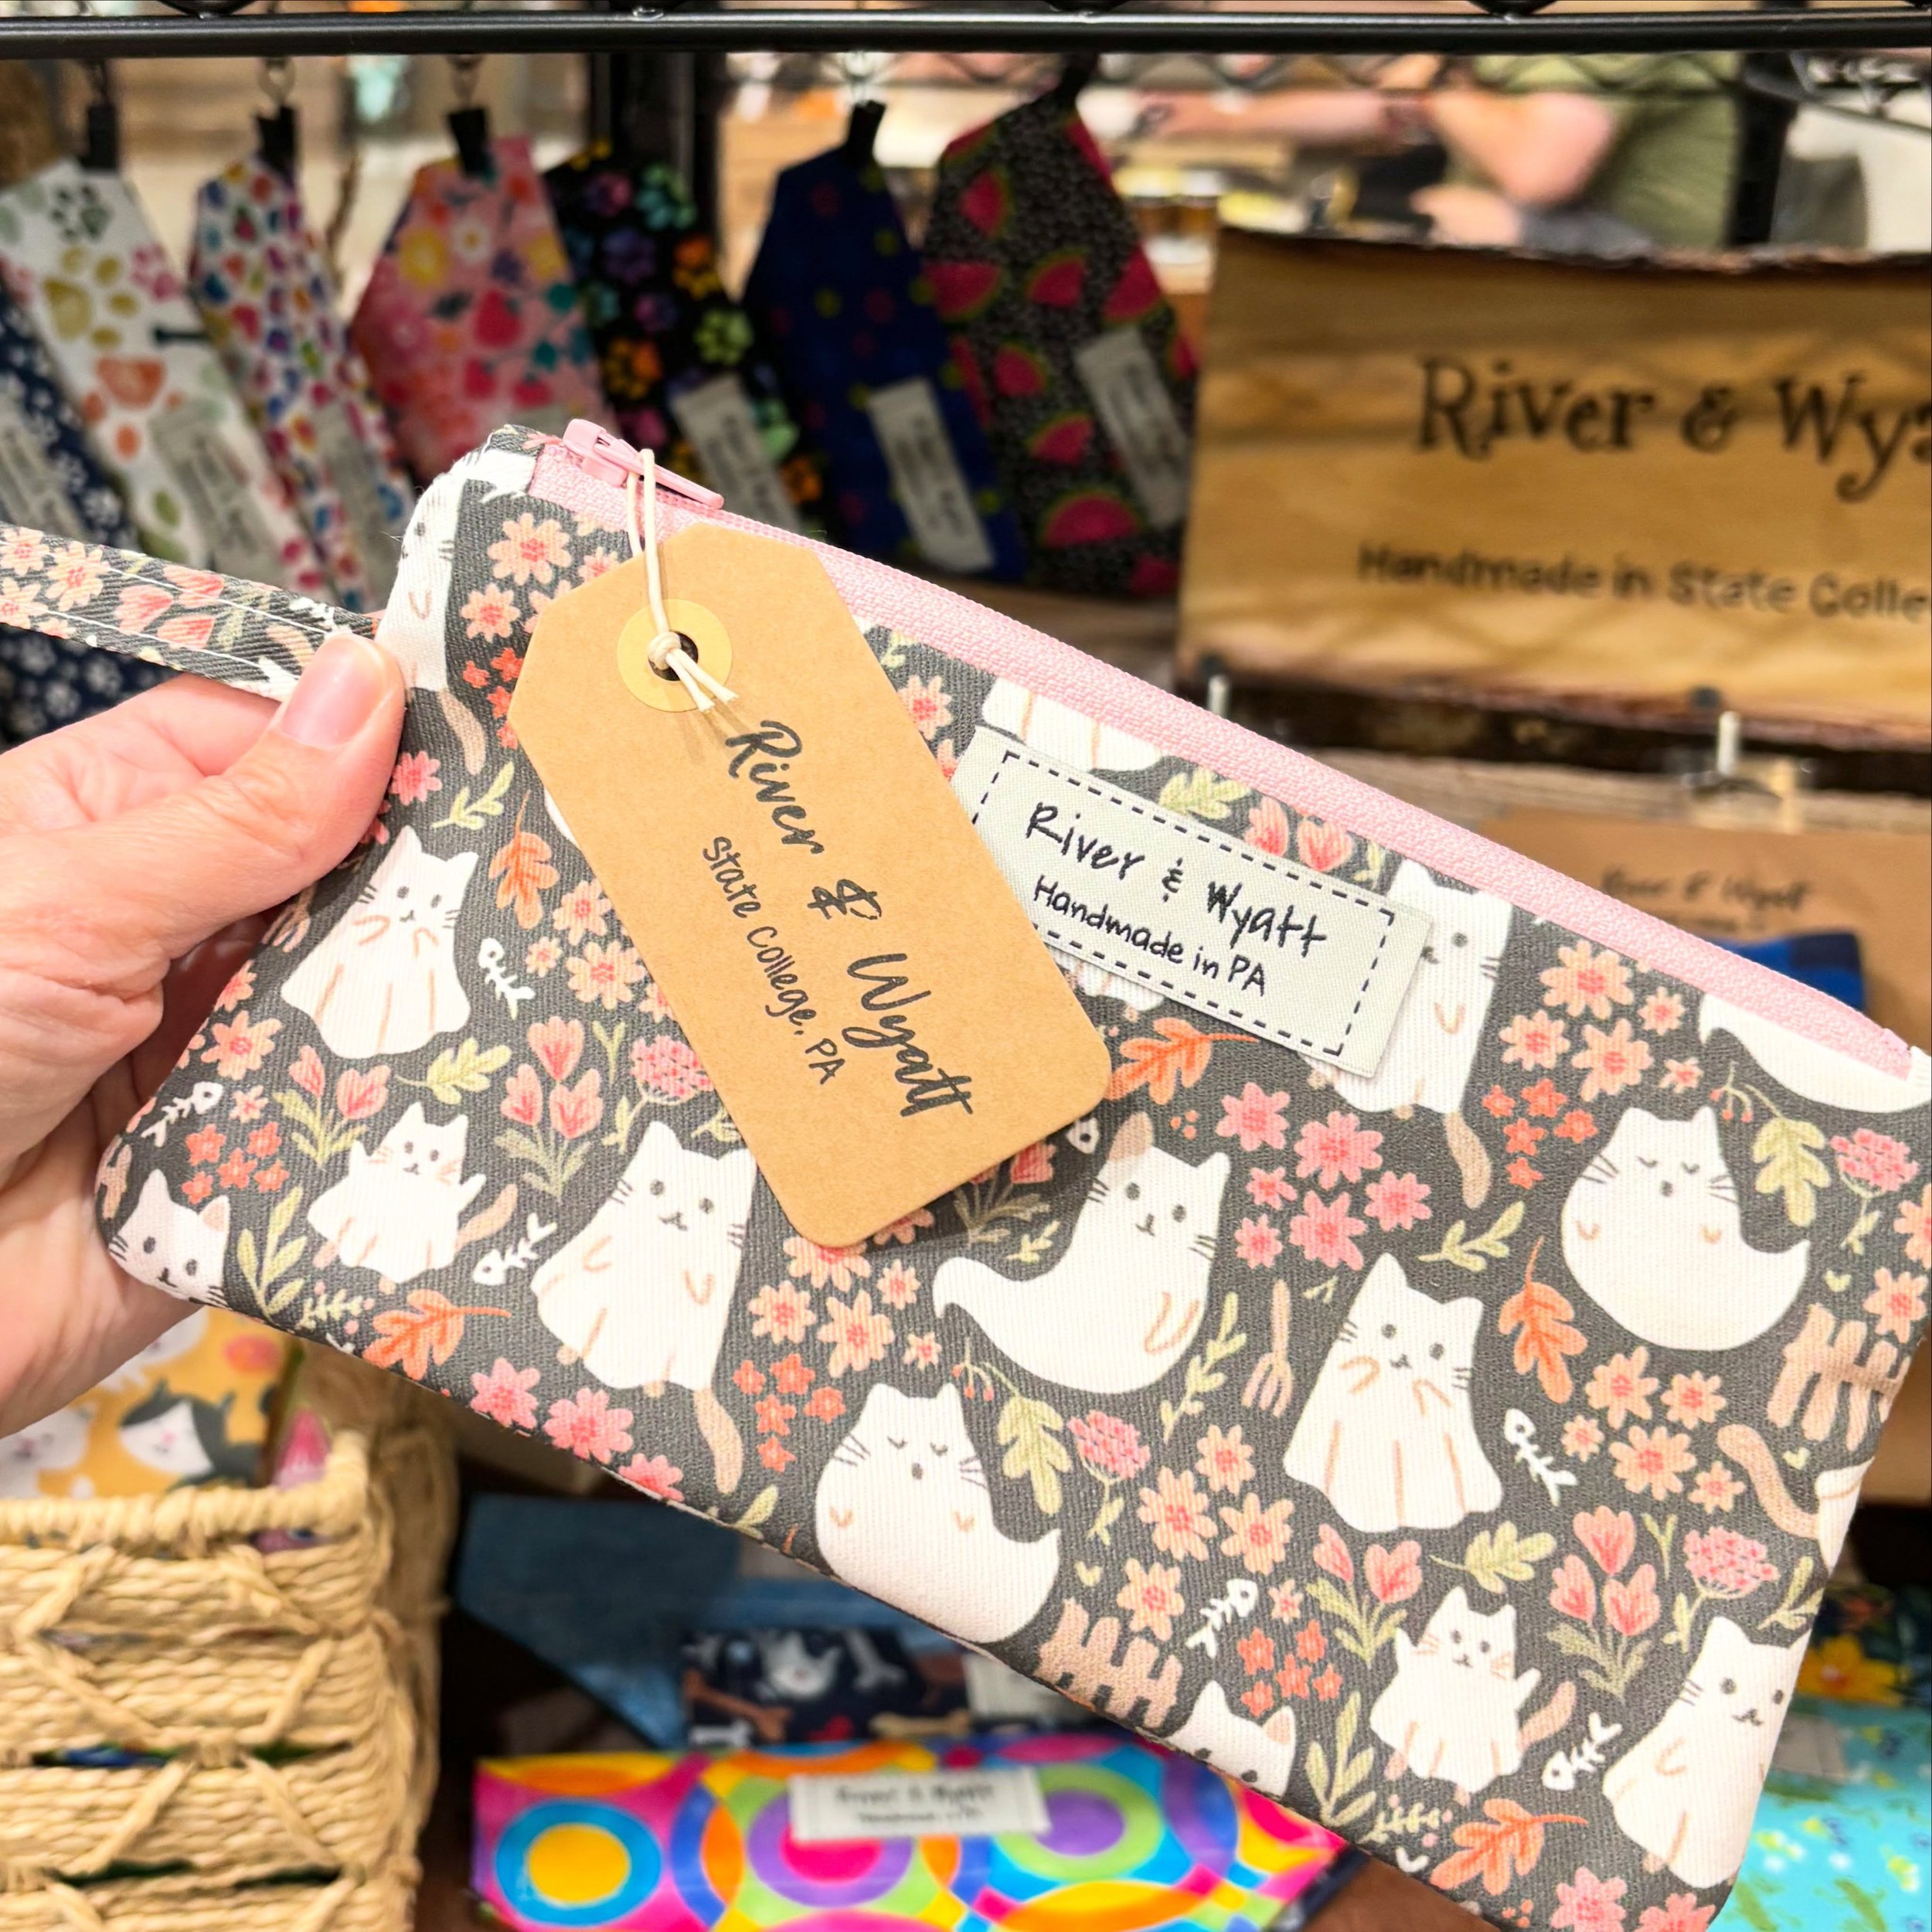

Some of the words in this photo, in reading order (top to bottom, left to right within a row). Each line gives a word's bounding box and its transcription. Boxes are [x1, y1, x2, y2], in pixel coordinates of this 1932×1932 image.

[1419, 355, 1655, 460] River
[1679, 381, 1735, 454] &
[1358, 543, 1601, 598] Handmade
[1612, 552, 1654, 600] in
[1668, 560, 1796, 612] State
[724, 720, 825, 855] River
[807, 879, 883, 920] &
[1025, 801, 1145, 881] River
[1161, 857, 1184, 903] &
[1206, 880, 1328, 958] Wyatt
[1032, 874, 1184, 964] Handmade
[1192, 946, 1219, 980] in
[1227, 954, 1266, 997] PA
[702, 836, 762, 919] State
[804, 1038, 846, 1085] PA
[842, 953, 974, 1118] Wyatt
